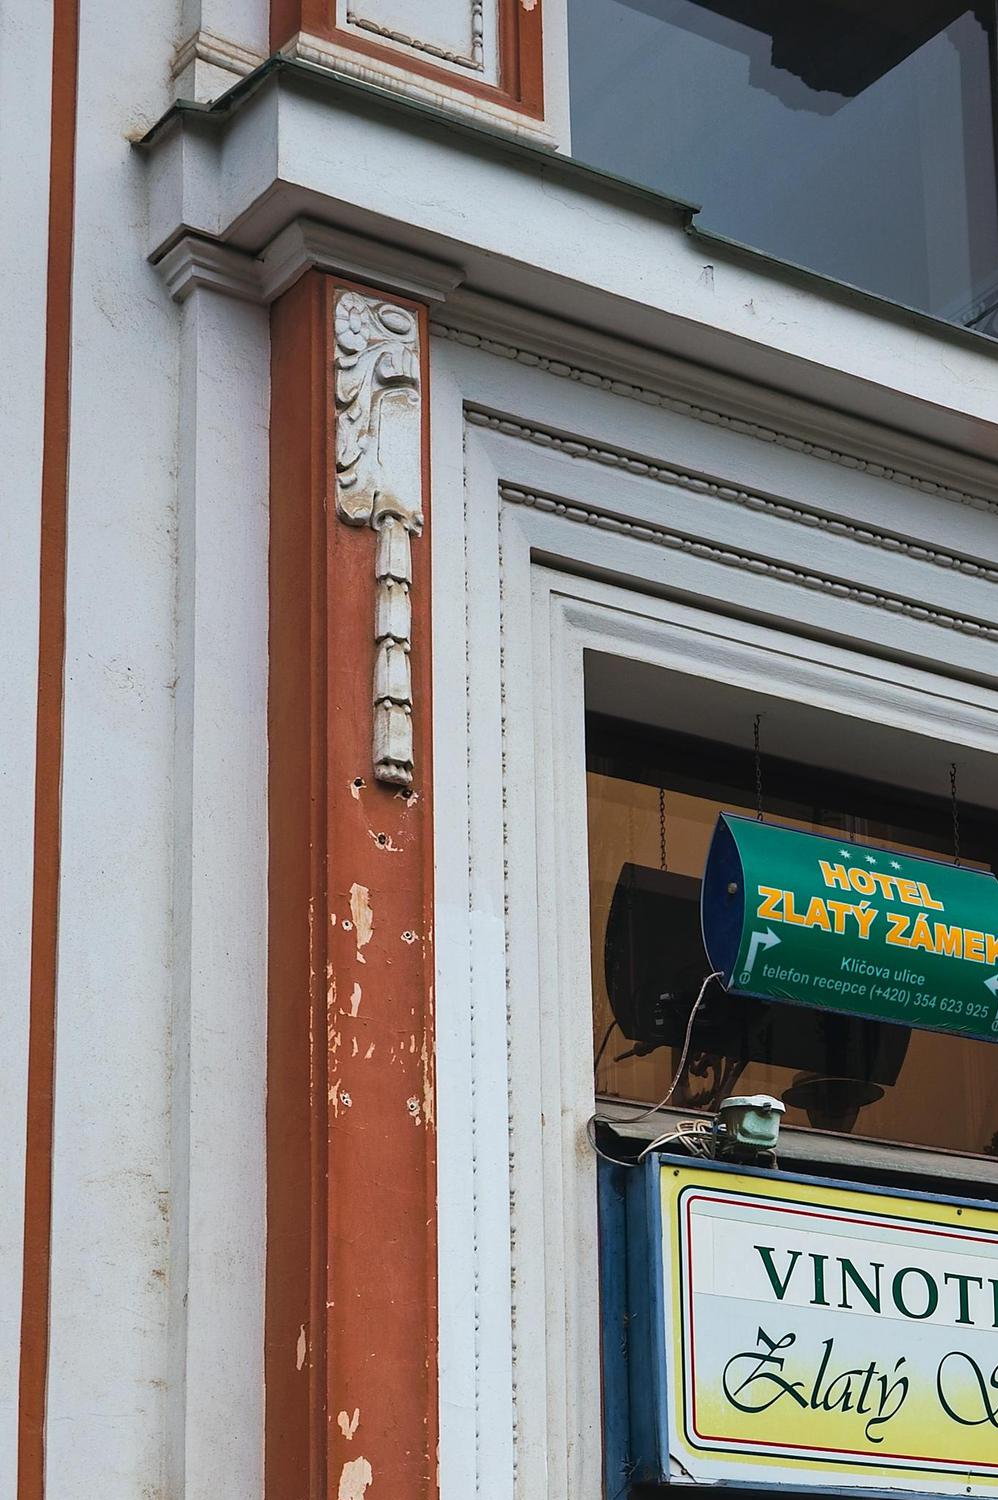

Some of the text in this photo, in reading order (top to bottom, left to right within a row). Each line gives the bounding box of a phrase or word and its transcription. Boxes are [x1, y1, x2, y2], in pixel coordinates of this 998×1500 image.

[757, 885, 878, 939] ZLATÝ
[819, 859, 944, 911] HOTEL
[762, 964, 989, 1019] telefon recepce (+420) 354 623 925
[894, 969, 925, 986] ulice
[722, 1326, 910, 1443] Zlatý
